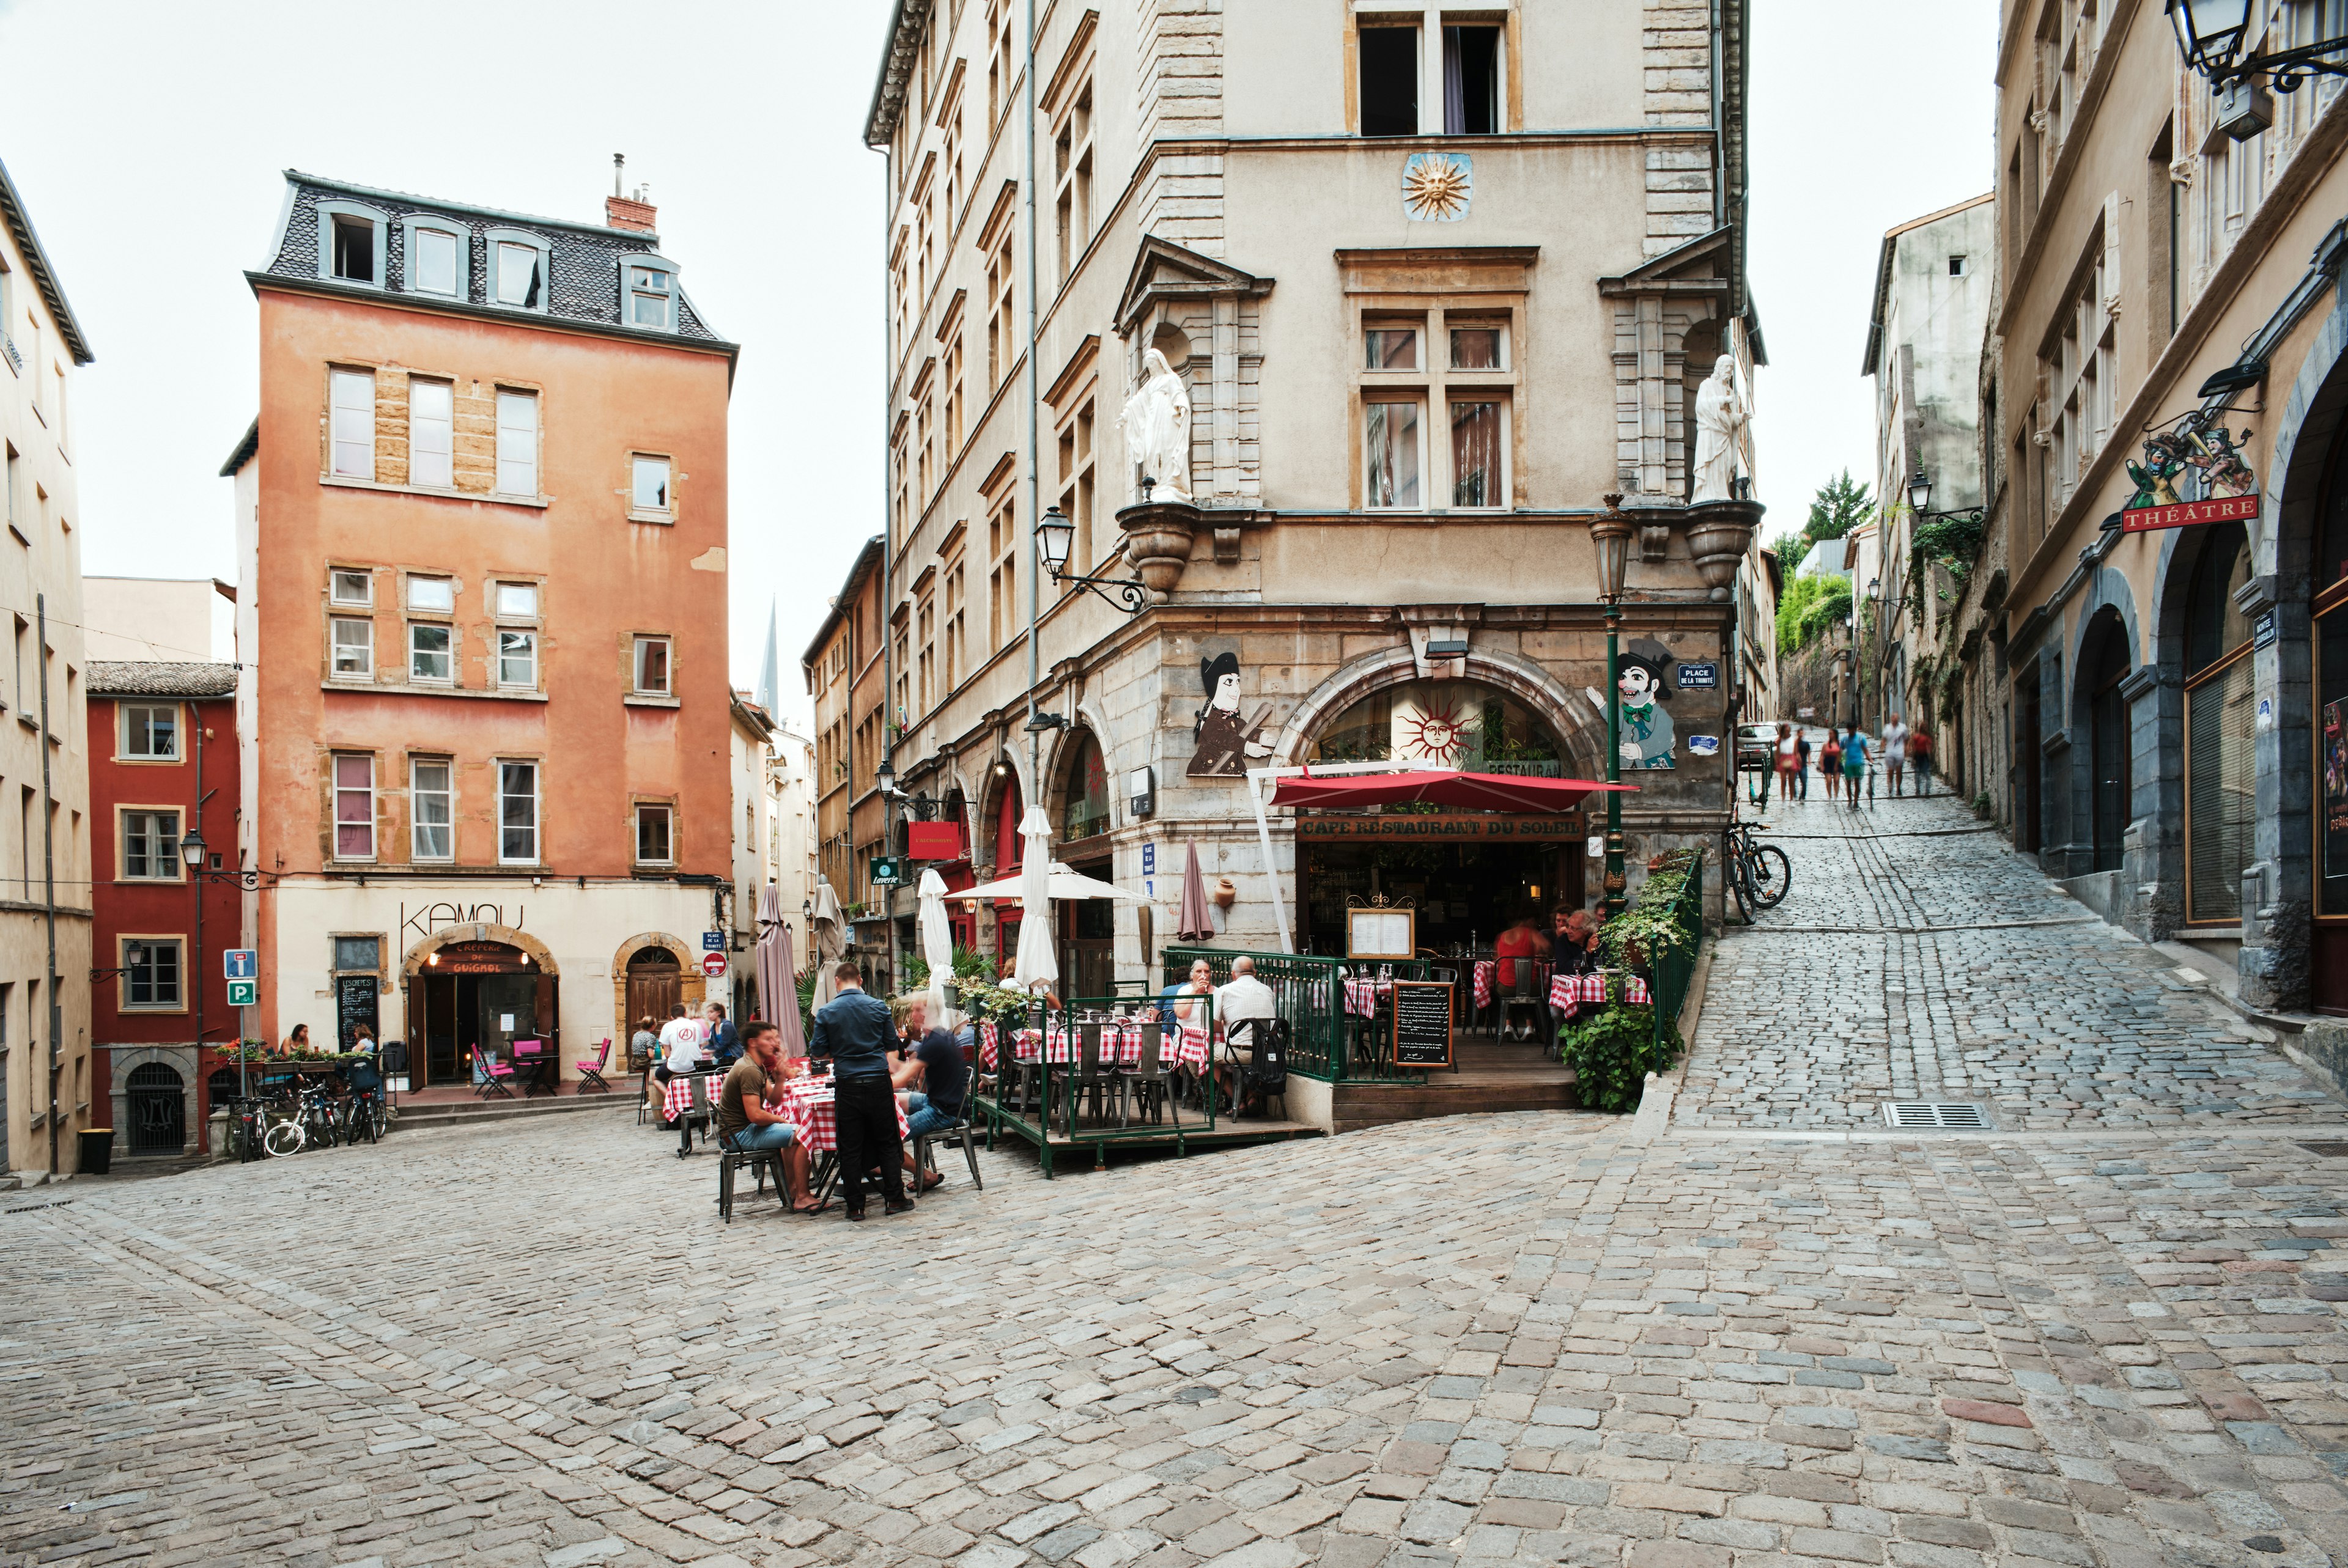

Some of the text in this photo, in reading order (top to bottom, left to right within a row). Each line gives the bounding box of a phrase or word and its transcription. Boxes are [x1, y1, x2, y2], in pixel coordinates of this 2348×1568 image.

[2125, 501, 2254, 527] THÉÂTRE
[1489, 764, 1567, 779] RESTAURAN
[1355, 822, 1480, 834] RESTAURANT
[1487, 822, 1513, 835] DU
[1519, 822, 1580, 834] SOLEIL
[1144, 863, 1153, 872] TRINITÉ
[873, 875, 898, 884] Laverie
[401, 902, 523, 962] KAMOU
[235, 985, 247, 1000] P
